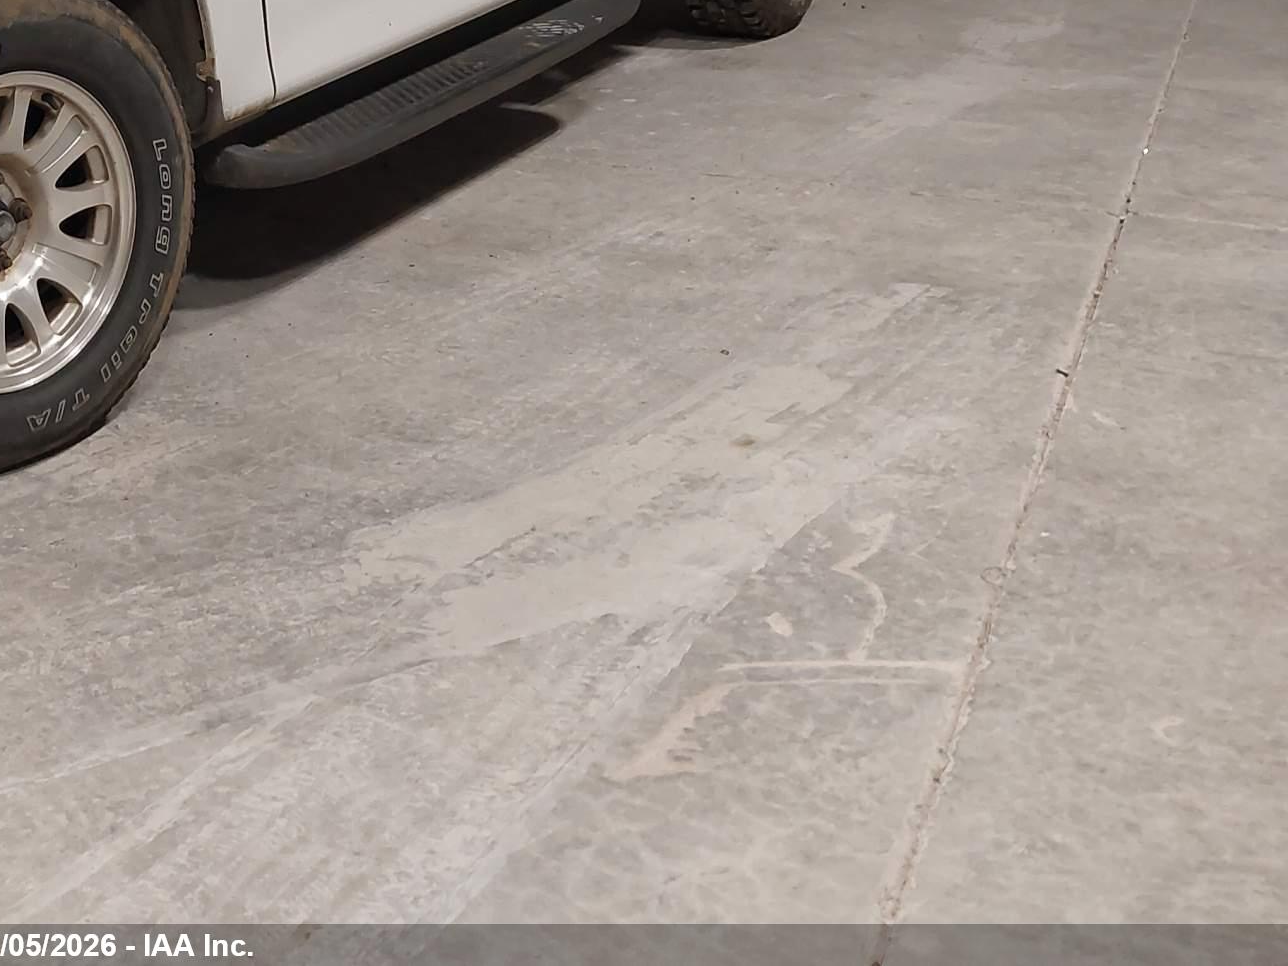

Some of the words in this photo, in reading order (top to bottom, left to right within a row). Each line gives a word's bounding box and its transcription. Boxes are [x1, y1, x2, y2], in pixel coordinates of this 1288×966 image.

[152, 138, 173, 255] Long
[100, 272, 164, 383] Trail
[26, 387, 90, 432] T/A
